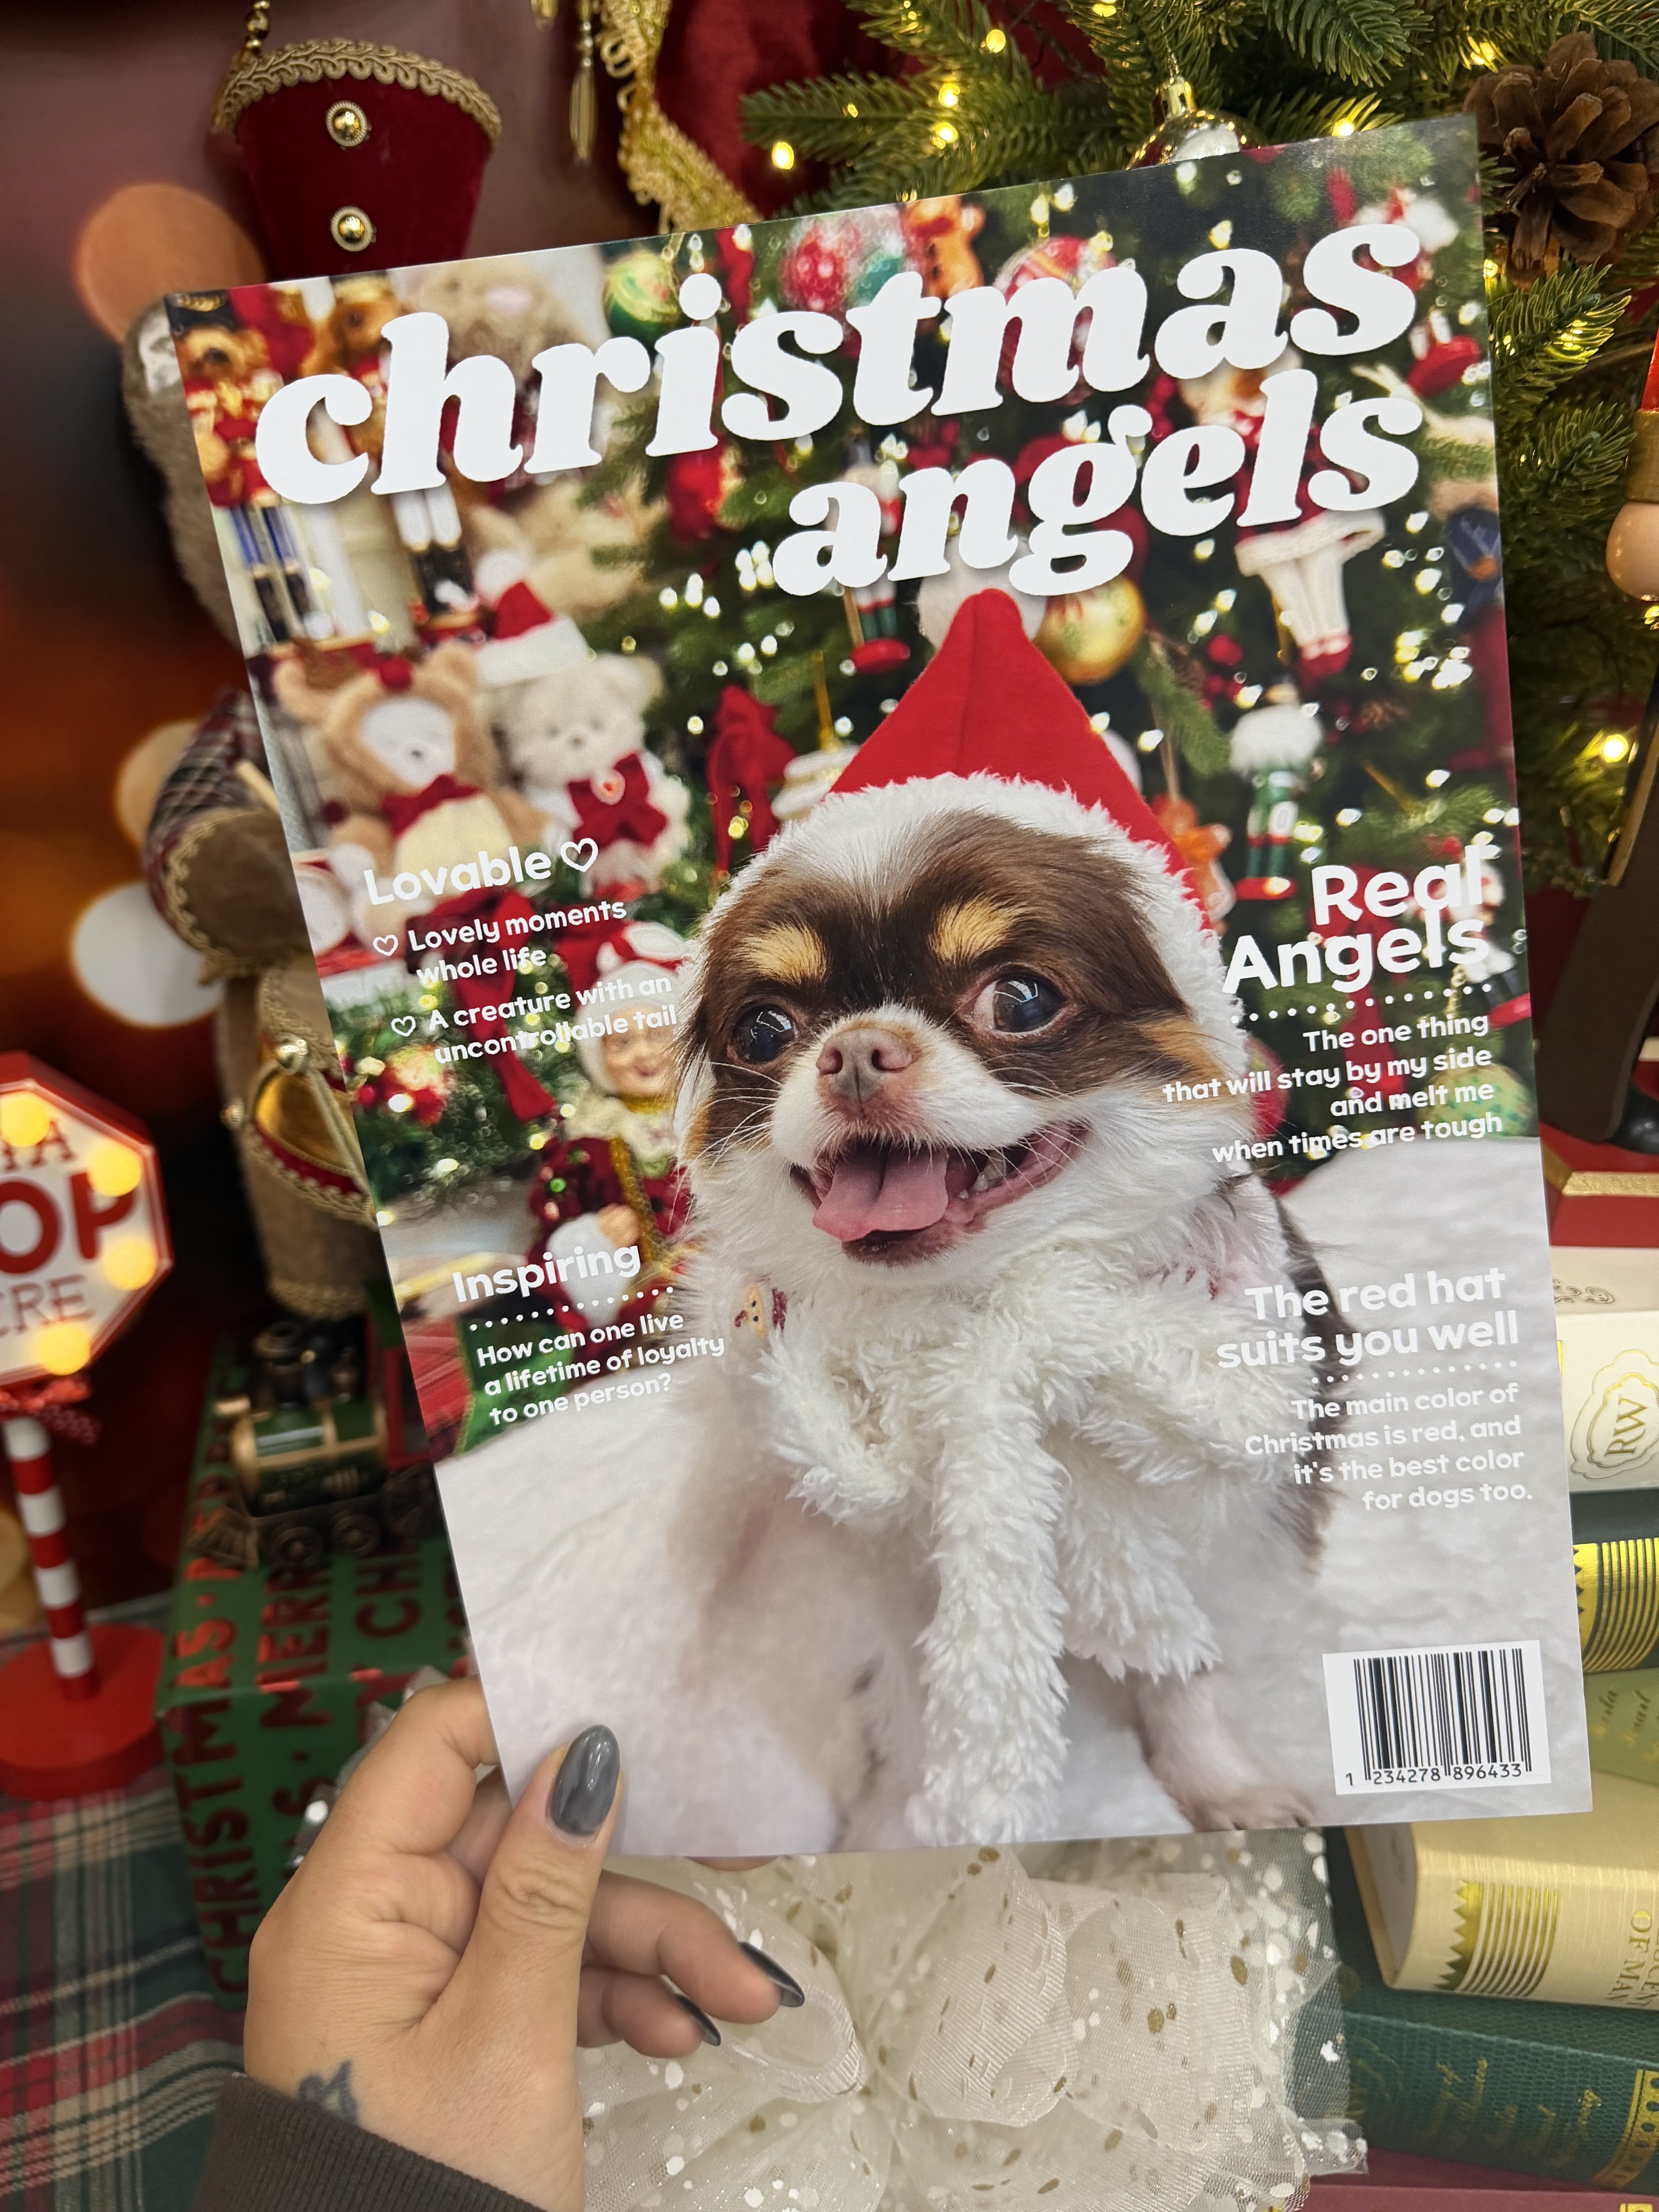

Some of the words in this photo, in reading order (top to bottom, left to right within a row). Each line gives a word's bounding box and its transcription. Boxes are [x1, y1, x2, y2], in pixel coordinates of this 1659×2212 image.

[254, 222, 1422, 505] christmas
[773, 369, 1424, 598] angels
[364, 846, 552, 905] Lovable
[1311, 845, 1483, 926] Real
[409, 917, 500, 952] Lovely
[507, 900, 627, 936] moments
[1222, 907, 1490, 994] Angels
[417, 955, 497, 985] whole
[503, 946, 547, 970] life
[429, 1009, 448, 1030] A
[454, 989, 571, 1027] creature
[575, 979, 634, 1006] with
[639, 976, 672, 996] an
[434, 1015, 629, 1064] uncontrollable
[633, 1004, 677, 1030] tail
[1303, 1030, 1354, 1052] The
[1361, 1023, 1411, 1046] one
[1416, 1013, 1489, 1039] thing
[1162, 1077, 1222, 1103] that
[1226, 1071, 1271, 1095] will
[1277, 1064, 1340, 1089] stay
[1346, 1060, 1381, 1083] by
[1387, 1055, 1428, 1081] my
[1434, 1046, 1492, 1070] side
[1330, 1091, 1381, 1117] and
[1389, 1084, 1448, 1110] melt
[1455, 1083, 1494, 1103] me
[1212, 1138, 1283, 1163] when
[1288, 1128, 1363, 1156] times
[1369, 1123, 1415, 1146] are
[1421, 1111, 1503, 1140] tough
[453, 1245, 640, 1303] Inspiring
[1245, 1284, 1329, 1320] The
[1338, 1273, 1417, 1312] red
[1427, 1267, 1506, 1305] hat
[477, 1340, 532, 1367] How
[539, 1332, 586, 1353] can
[590, 1323, 635, 1343] one
[640, 1313, 684, 1335] live
[1216, 1330, 1326, 1369] suits
[1335, 1327, 1418, 1366] you
[1428, 1309, 1518, 1351] well
[484, 1379, 501, 1396] a
[504, 1357, 601, 1393] lifetime
[606, 1349, 633, 1372] of
[637, 1337, 725, 1366] loyalty
[490, 1406, 518, 1425] to
[524, 1395, 568, 1419] one
[573, 1373, 672, 1412] person?
[1291, 1397, 1340, 1420] The
[1345, 1393, 1409, 1416] main
[1415, 1387, 1484, 1410] color
[1489, 1382, 1518, 1404] of
[1603, 1396, 1647, 1456] RW
[1245, 1431, 1379, 1455] Christmas
[1383, 1424, 1407, 1445] is
[1412, 1420, 1464, 1443] red,
[1470, 1415, 1521, 1439] and
[1293, 1462, 1334, 1484] it's
[1338, 1460, 1383, 1480] the
[1388, 1455, 1449, 1477] best
[1455, 1449, 1524, 1472] color
[1362, 1490, 1401, 1511] for
[1408, 1486, 1475, 1508] dogs
[1480, 1483, 1533, 1502] too.
[256, 1565, 334, 1728] MERR
[1346, 1773, 1353, 1785] 1
[1373, 1767, 1441, 1784] 234278
[1453, 1763, 1522, 1779] 896433
[1631, 1909, 1652, 1953] OF
